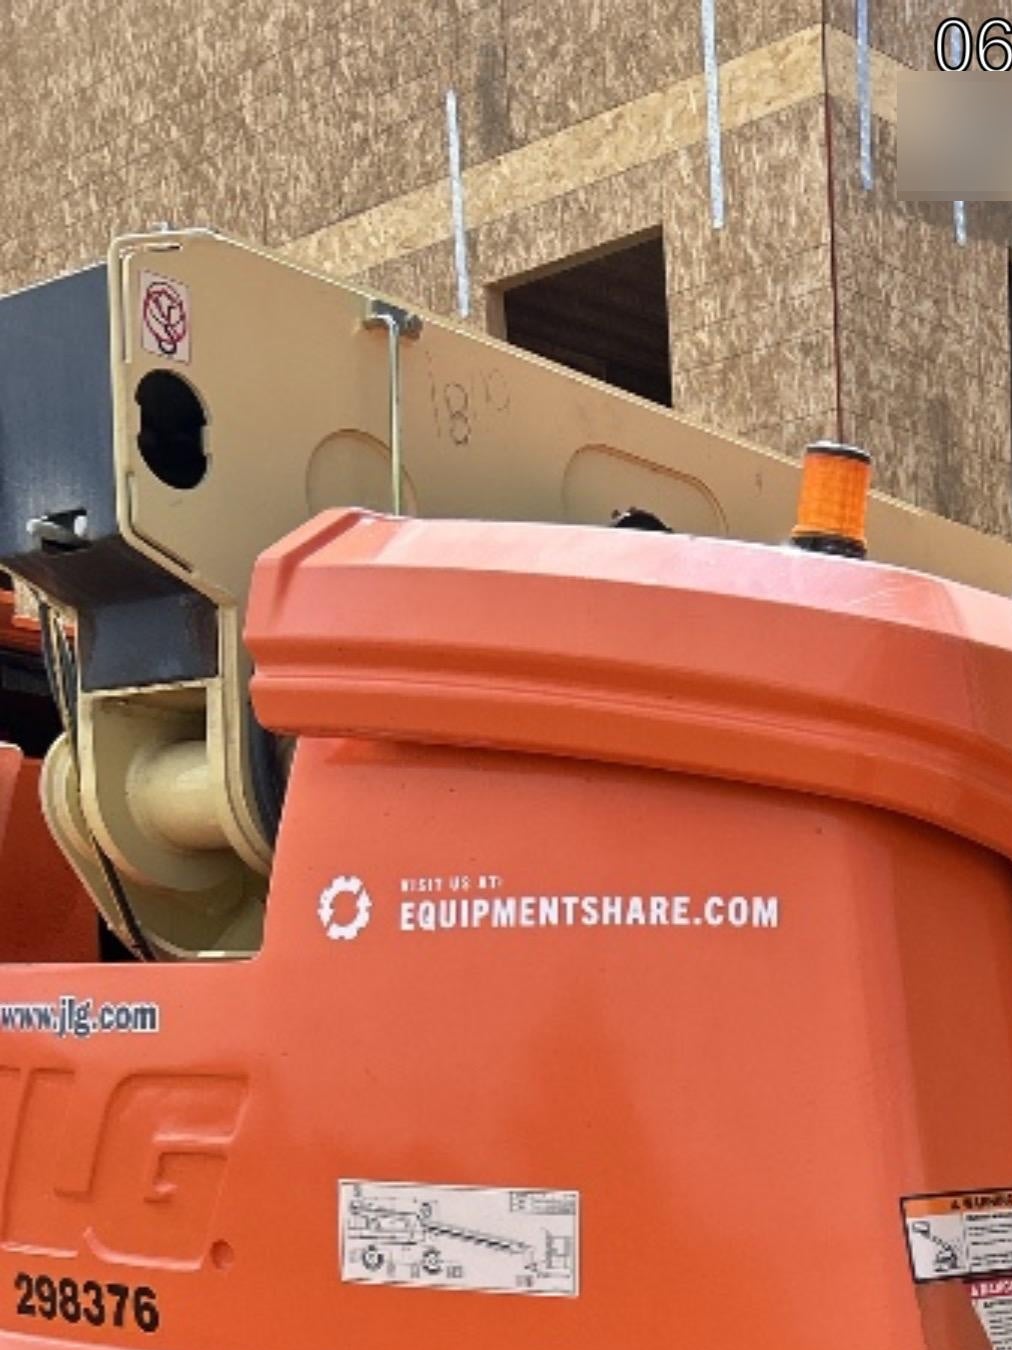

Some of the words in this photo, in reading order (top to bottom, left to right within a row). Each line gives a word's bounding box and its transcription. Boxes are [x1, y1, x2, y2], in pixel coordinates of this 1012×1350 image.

[400, 896, 779, 931] EQUIPMENTSHARE.COM
[0, 996, 159, 1037] www.jlg.com
[14, 1272, 160, 1333] 298376
